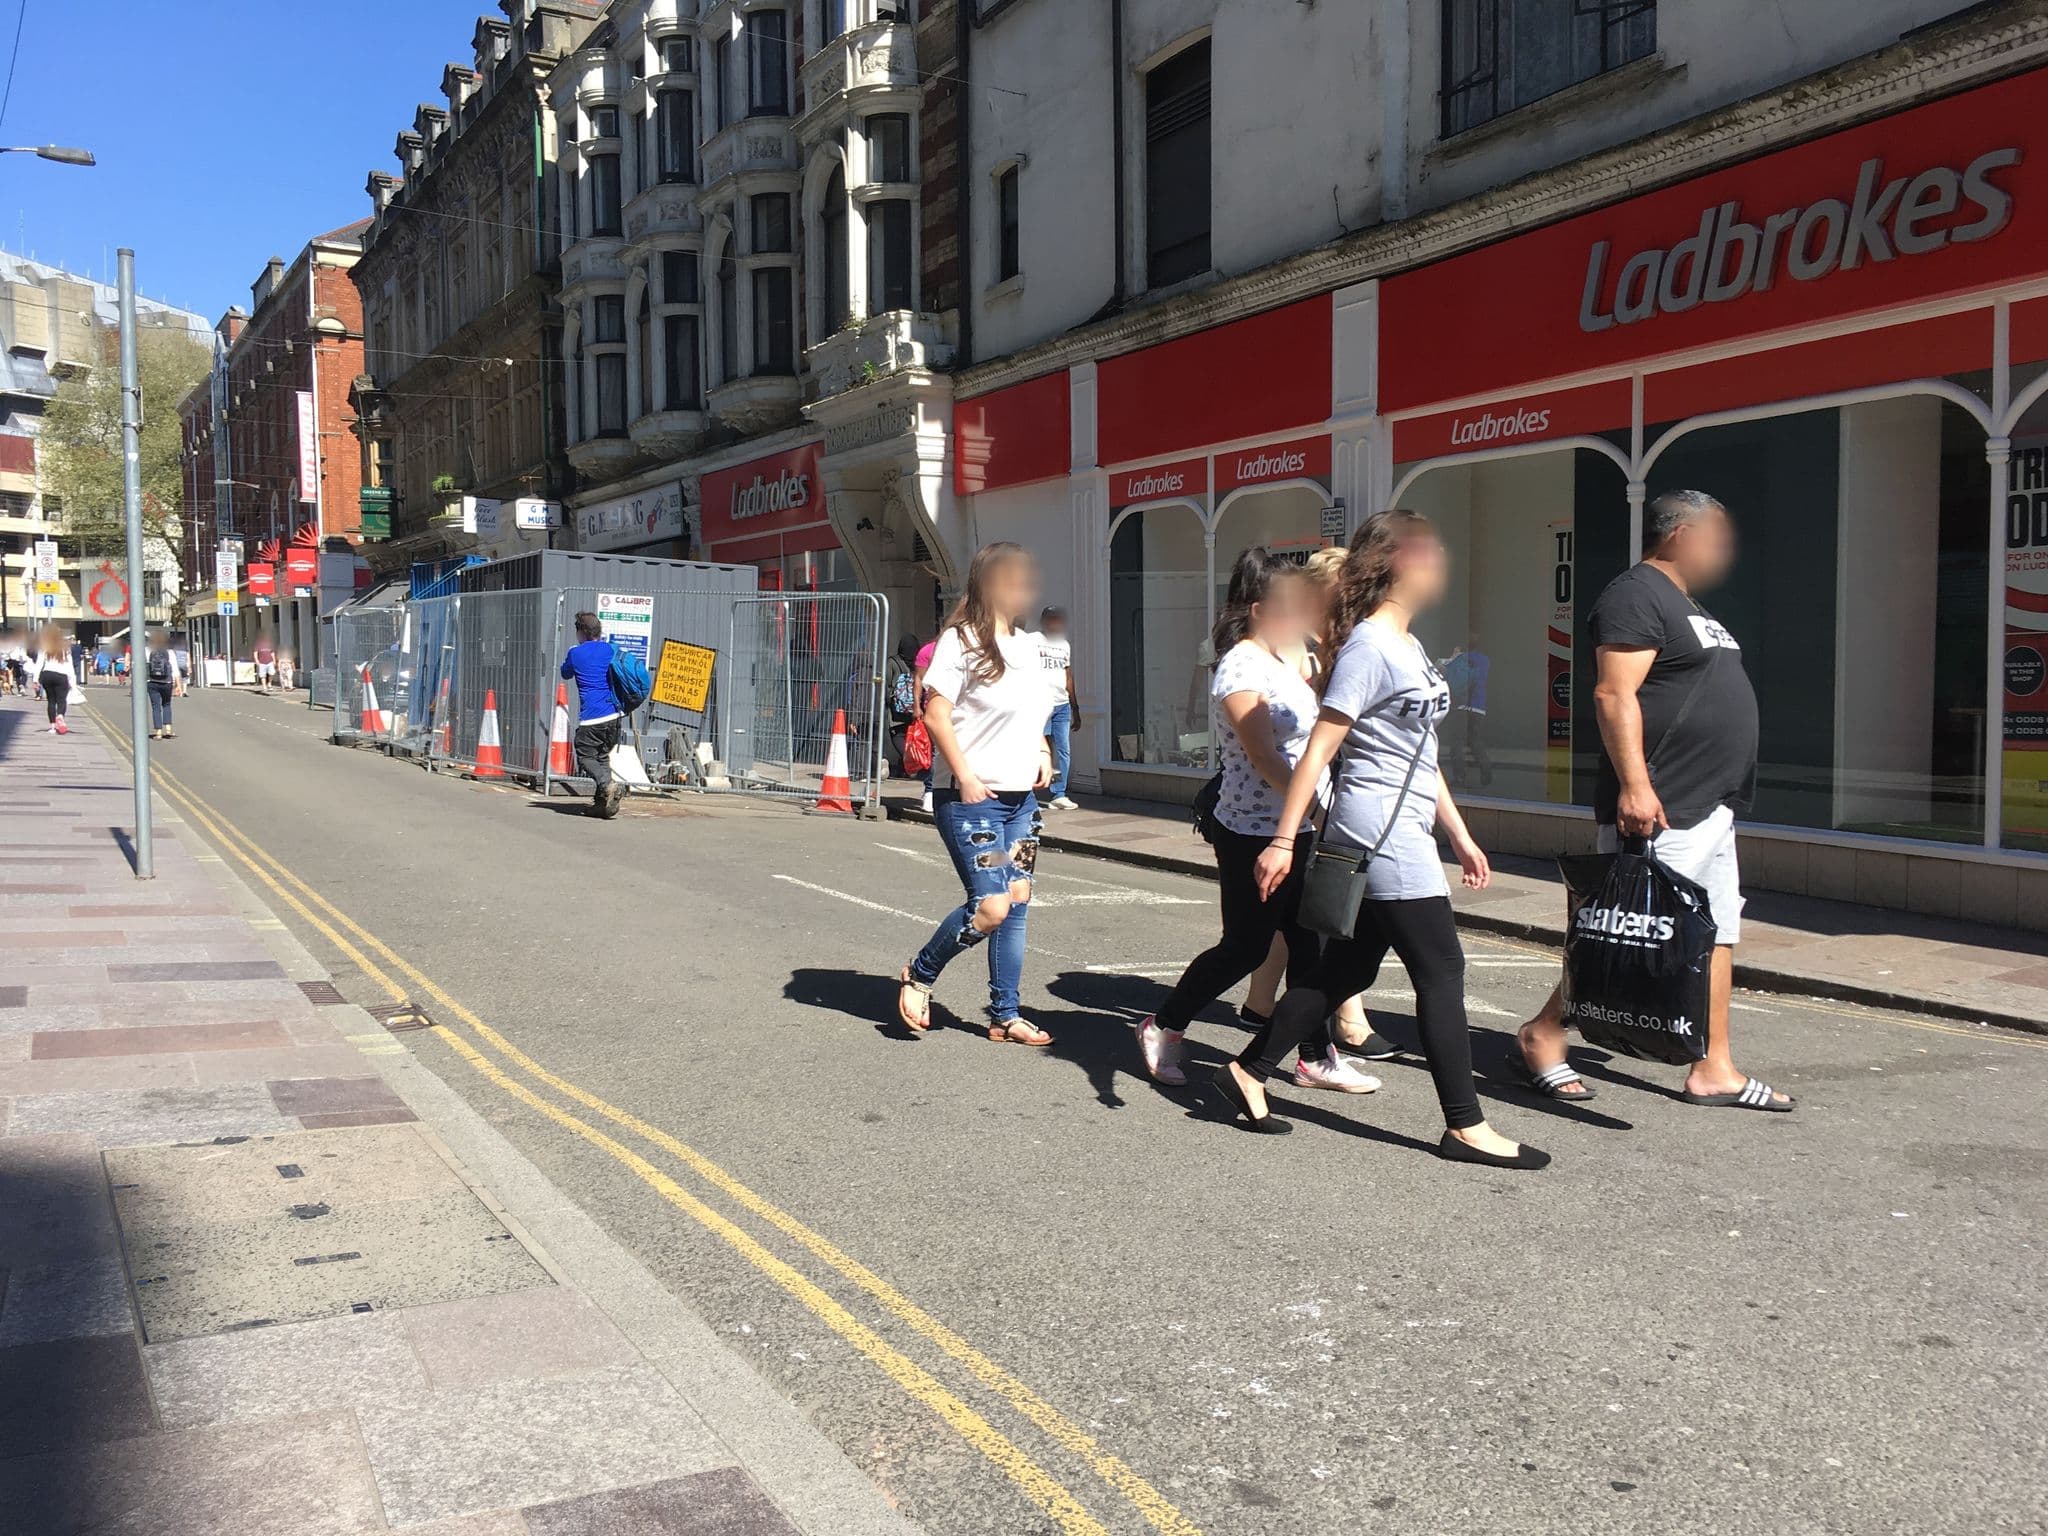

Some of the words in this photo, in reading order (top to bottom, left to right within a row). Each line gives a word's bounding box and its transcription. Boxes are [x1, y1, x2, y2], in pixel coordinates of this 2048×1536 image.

[1578, 147, 2023, 332] Ladbrokes
[1451, 407, 1551, 445] Ladbrokes
[1237, 450, 1306, 480] Ladbrokes
[1128, 472, 1185, 498] Ladbrokes
[731, 469, 808, 520] Ladbrokes
[527, 516, 553, 525] MUSIC
[2007, 553, 2032, 562] FOR
[680, 647, 702, 658] MUSIC
[662, 670, 674, 680] GM
[677, 674, 705, 688] MUSIC
[662, 681, 686, 693] OPEN
[687, 687, 700, 697] AS
[664, 692, 692, 706] USUAL
[2016, 716, 2044, 724] ODDS
[2016, 727, 2044, 735] ODDS
[1575, 899, 1676, 941] slaters
